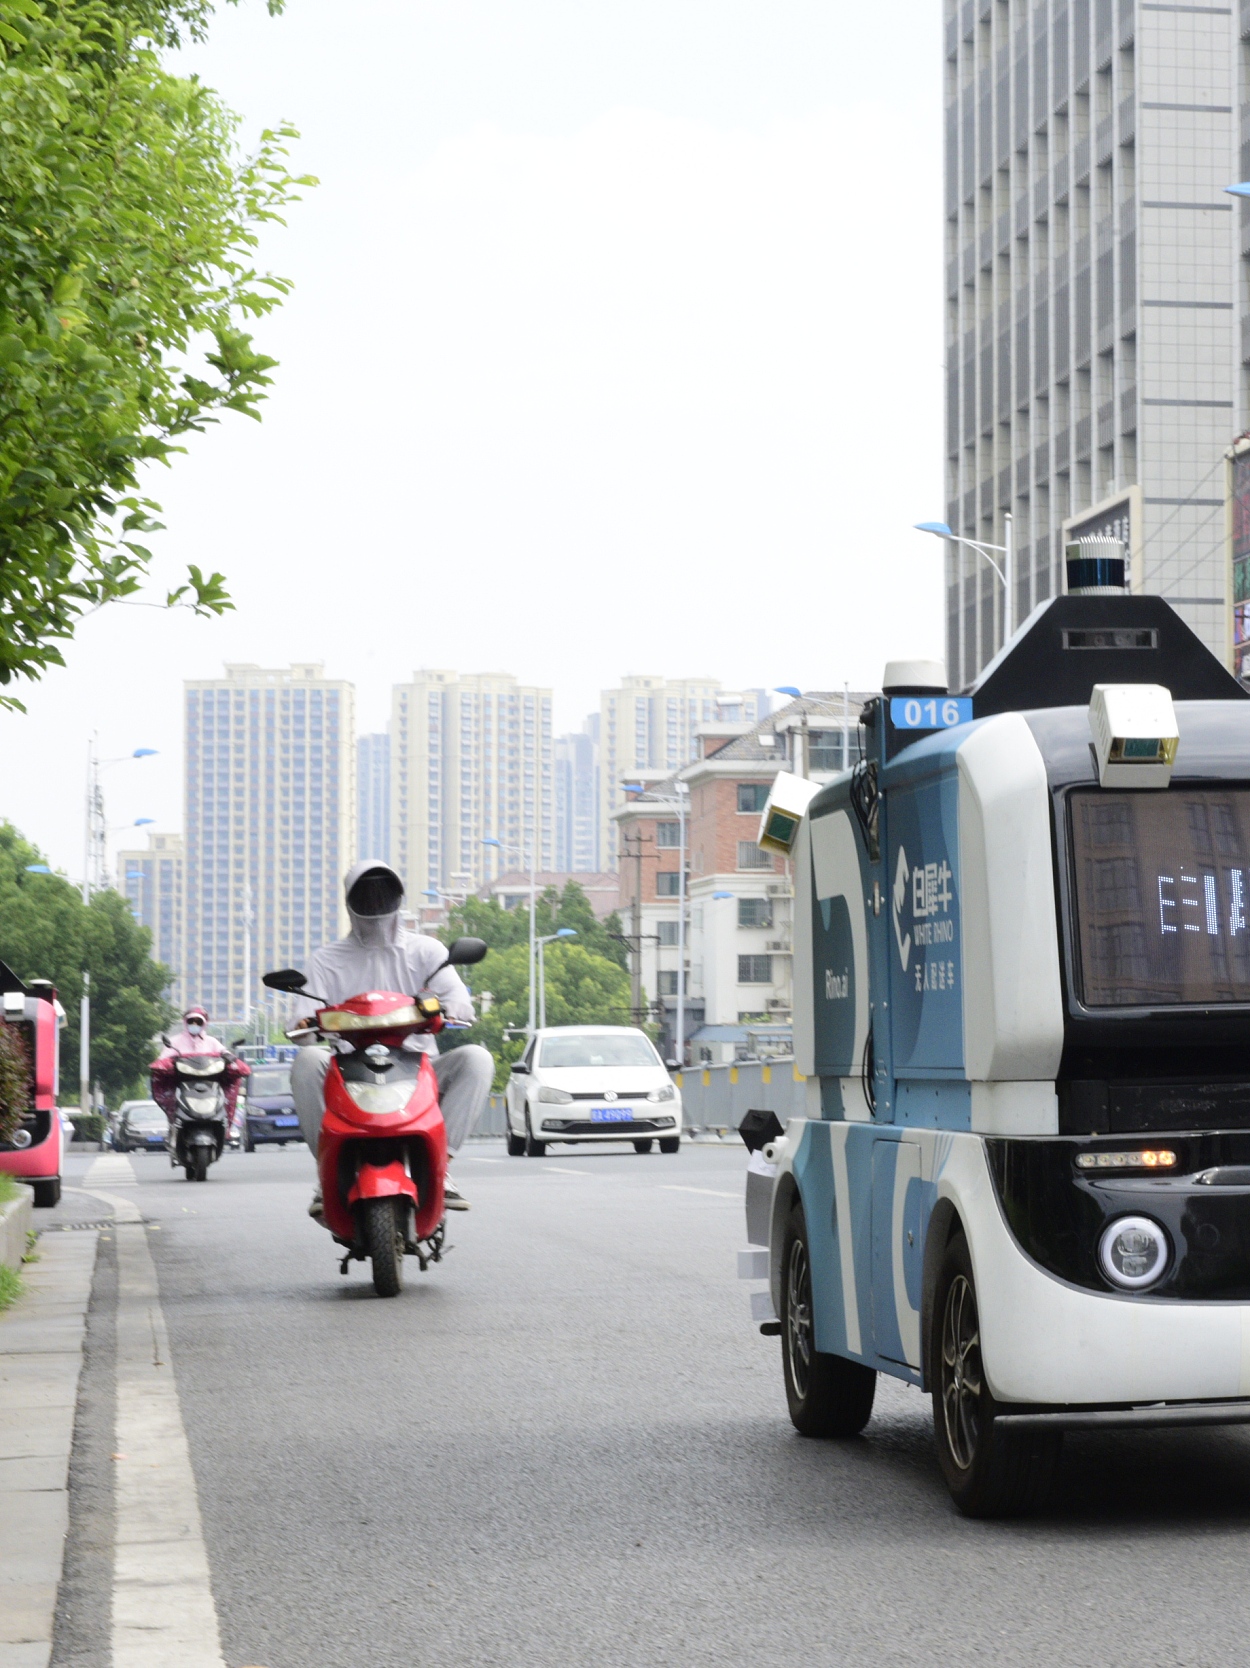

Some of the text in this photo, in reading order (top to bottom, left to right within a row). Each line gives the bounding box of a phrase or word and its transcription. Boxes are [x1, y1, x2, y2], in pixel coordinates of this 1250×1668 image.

[904, 700, 960, 726] 016
[912, 860, 953, 918] 白犀牛
[913, 919, 954, 947] WHITE RHINO
[825, 966, 848, 999] Rino.ai
